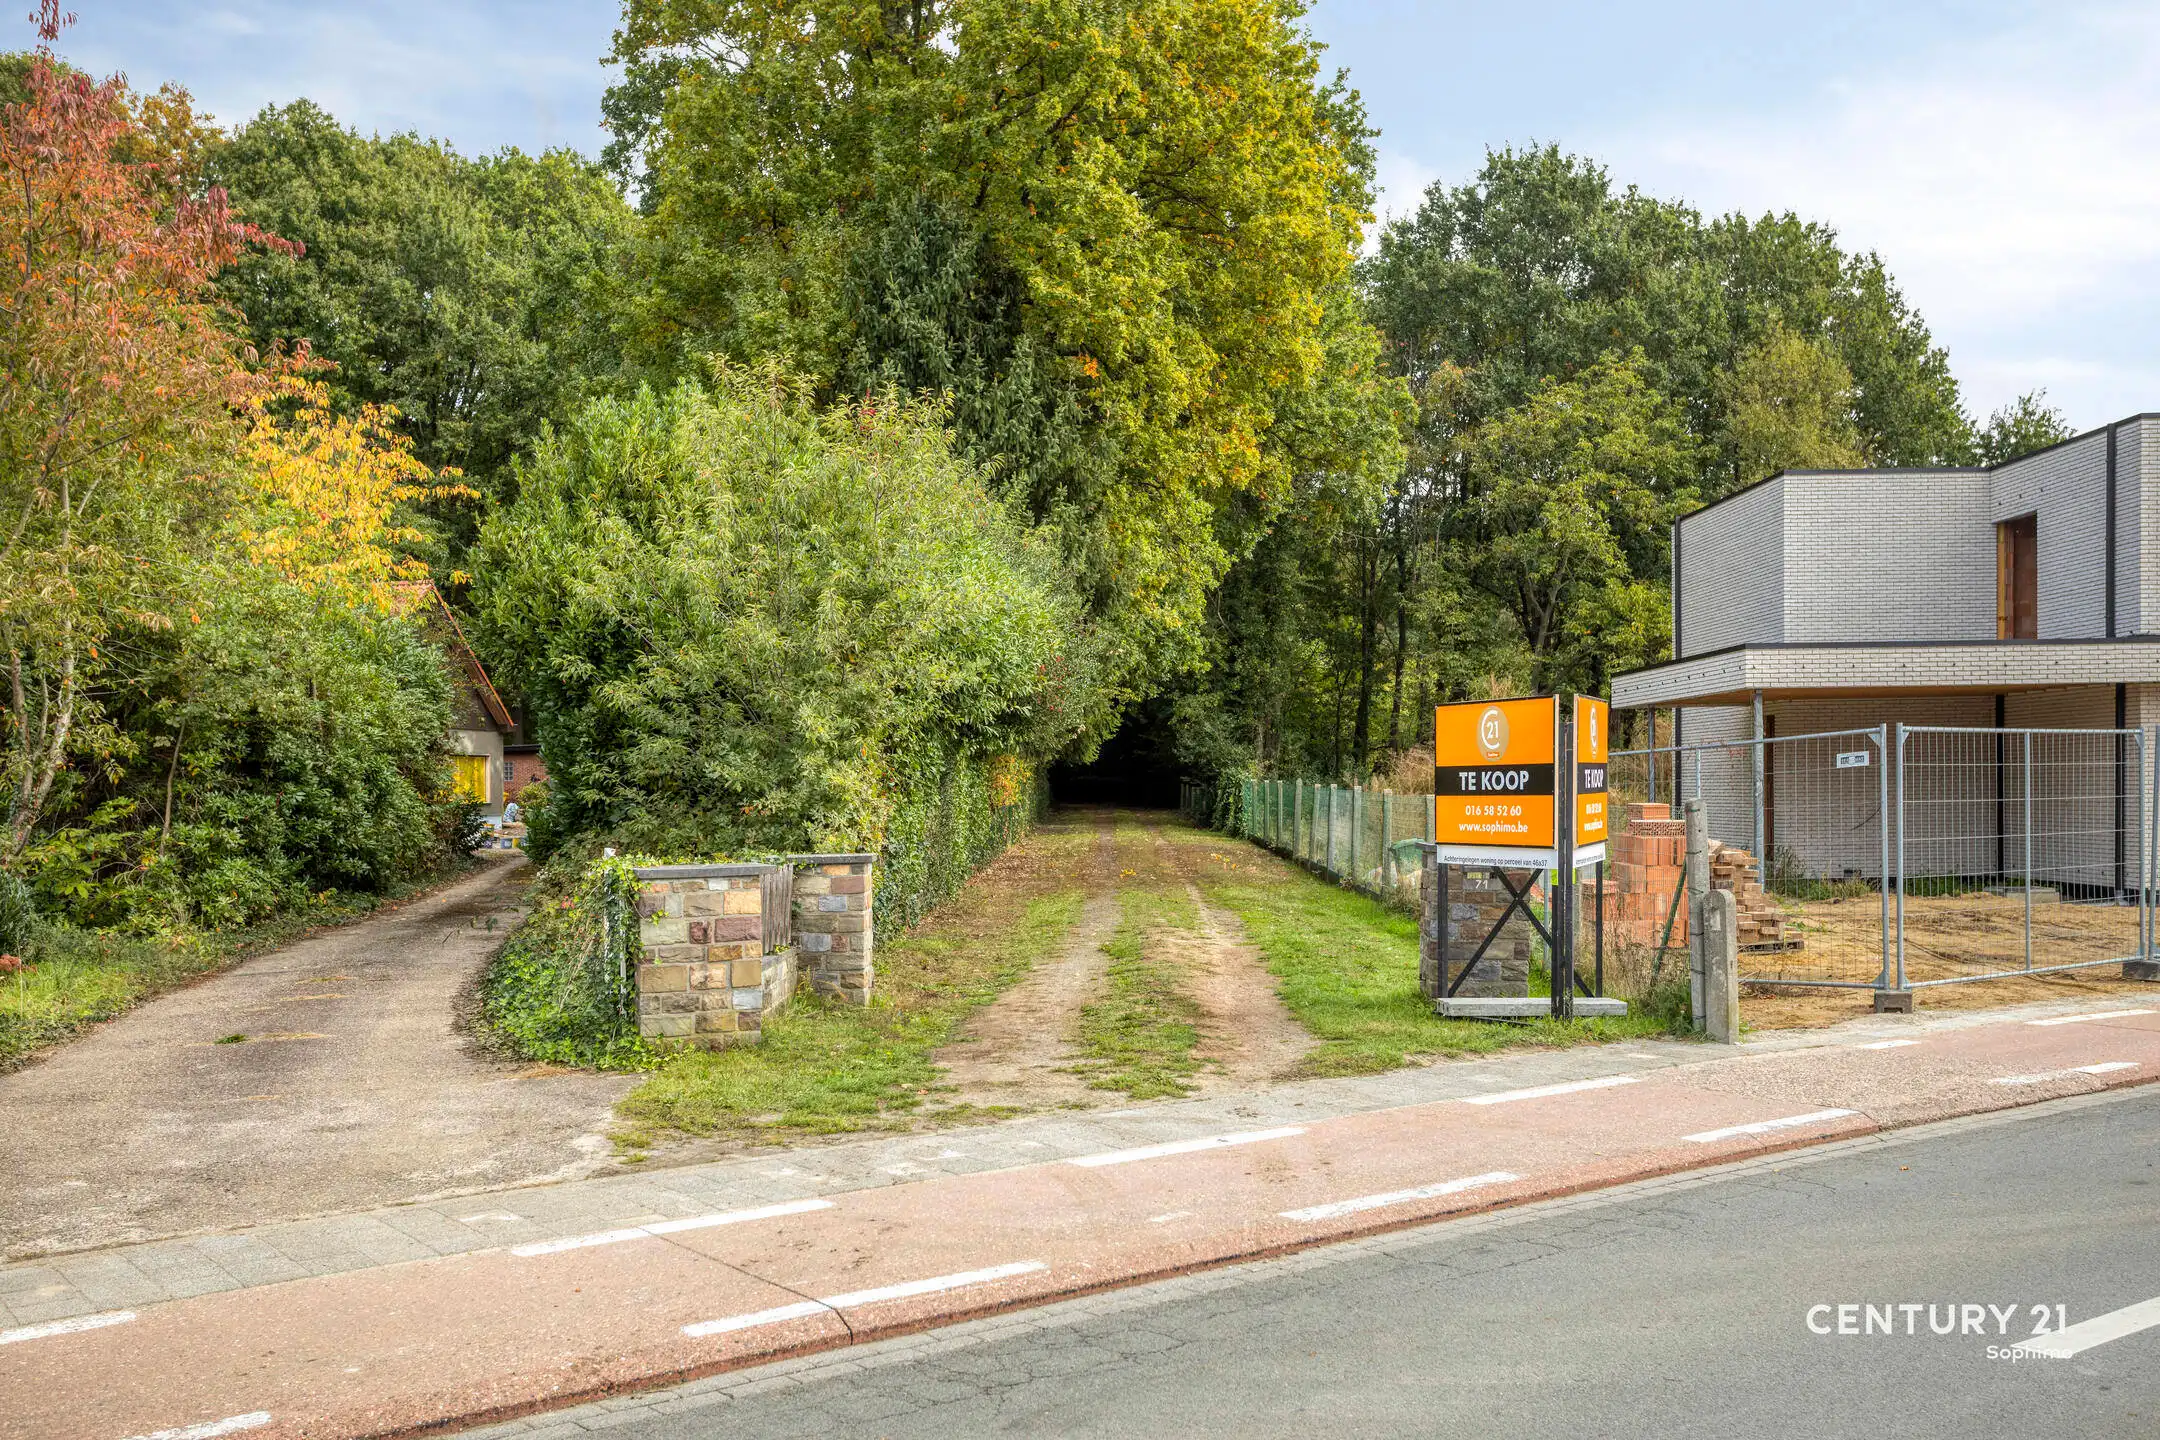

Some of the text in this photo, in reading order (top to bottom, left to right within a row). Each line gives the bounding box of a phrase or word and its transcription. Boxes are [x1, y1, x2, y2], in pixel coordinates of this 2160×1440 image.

[1486, 720, 1499, 739] 21
[1458, 770, 1529, 791] TE KOOP
[1584, 768, 1604, 789] TE KOOP
[1465, 805, 1522, 816] 016 58 52 60
[1459, 820, 1529, 835] www.sophimo.be
[1475, 879, 1489, 890] 71
